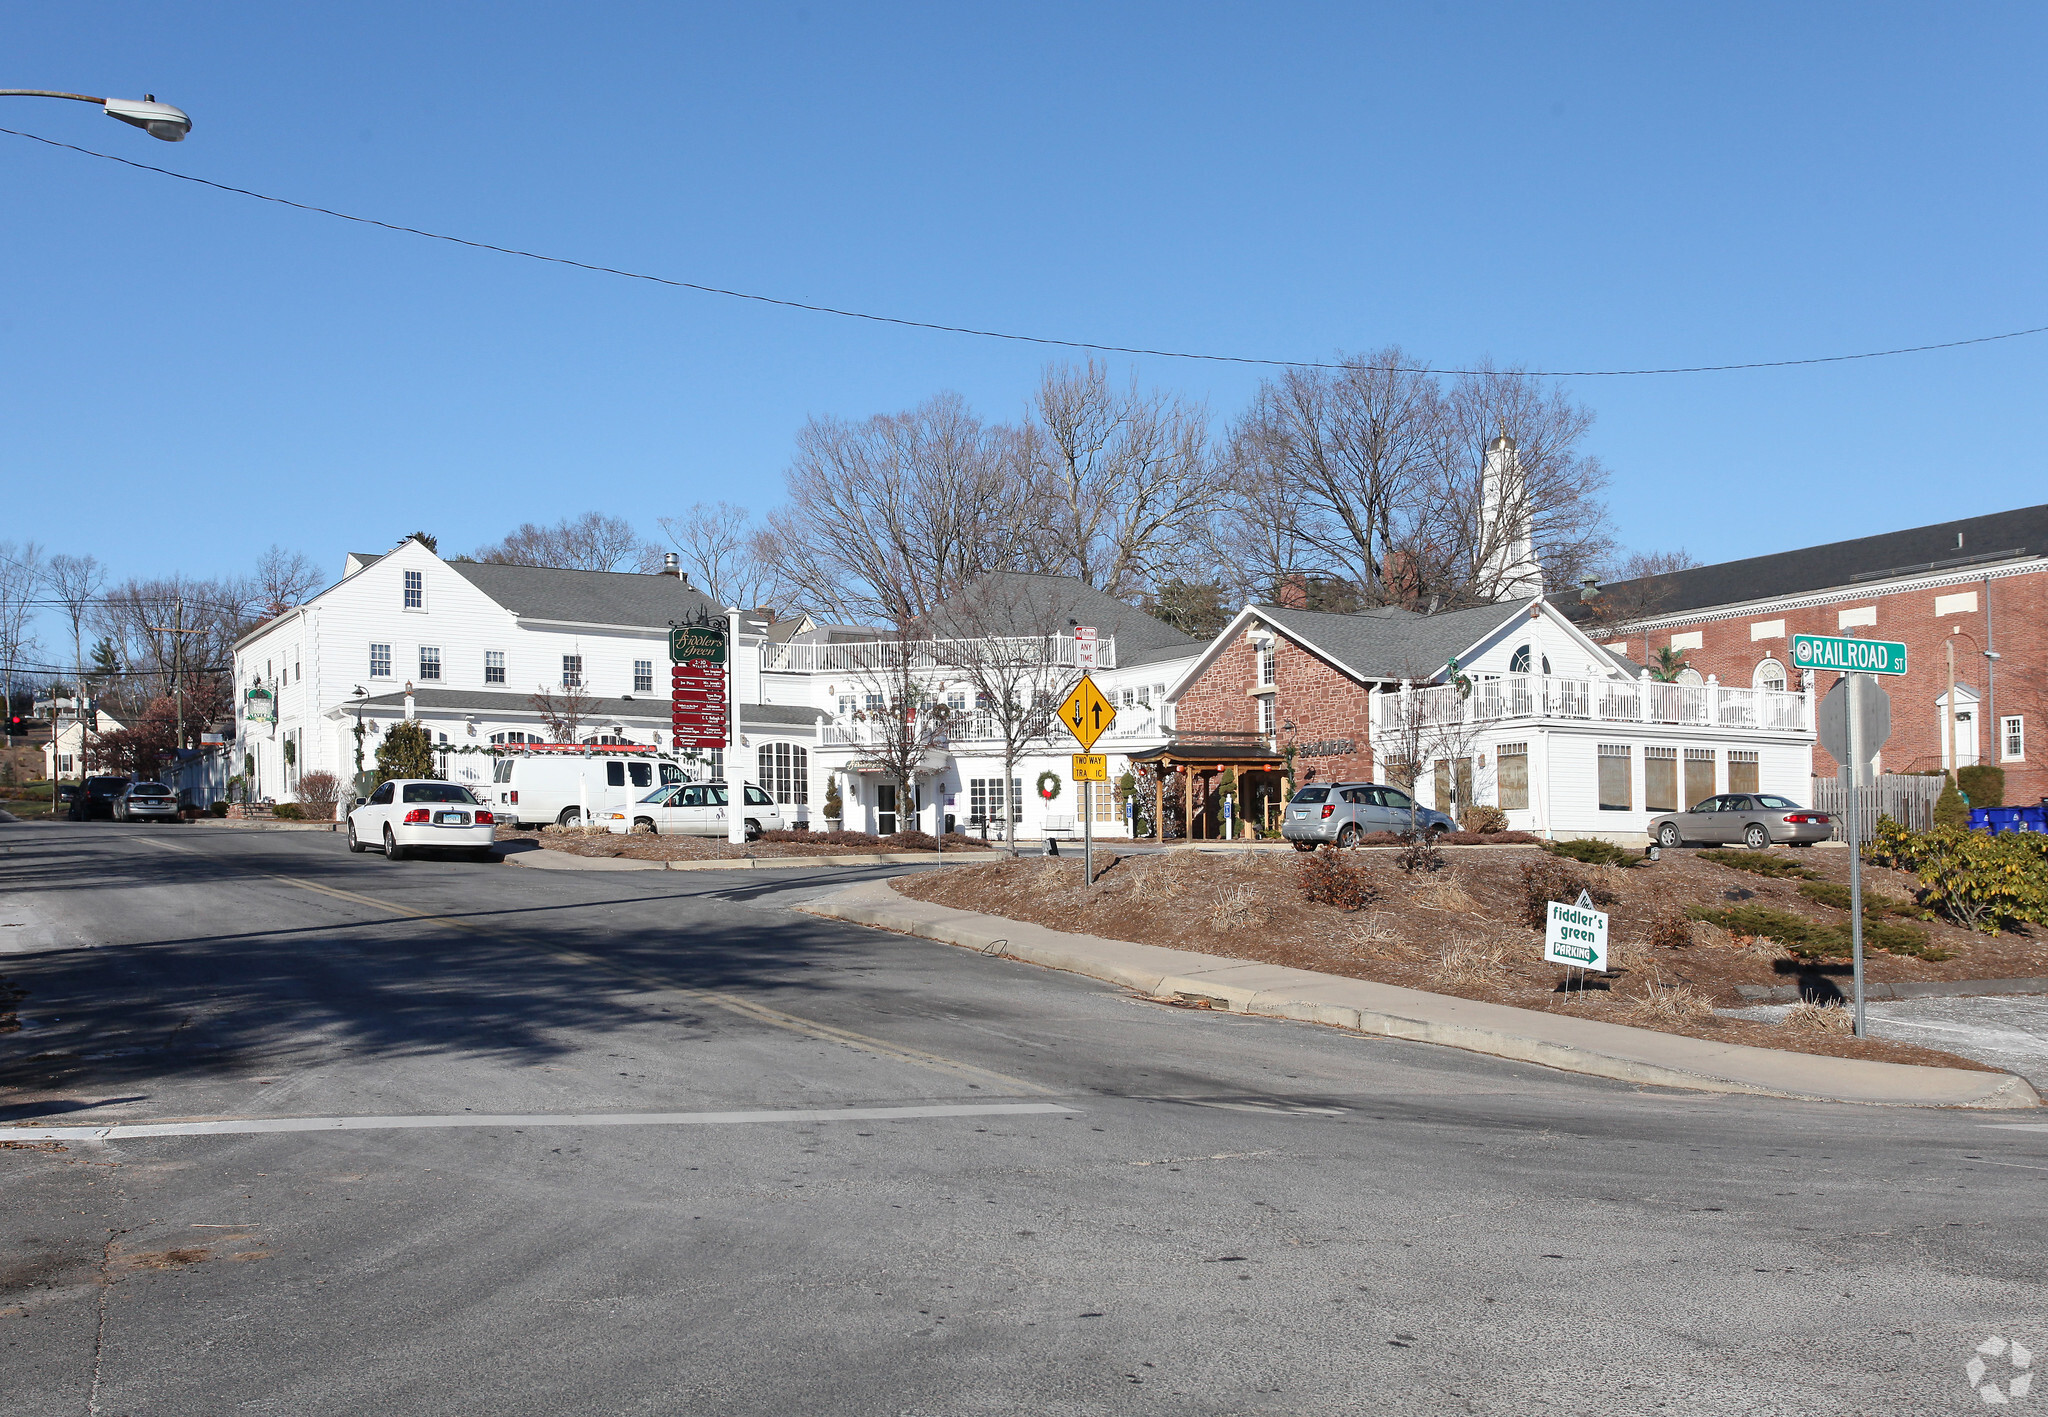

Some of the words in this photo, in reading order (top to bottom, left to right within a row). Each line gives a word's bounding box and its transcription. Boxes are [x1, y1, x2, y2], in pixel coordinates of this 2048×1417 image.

[1081, 643, 1093, 651] ANY
[1080, 653, 1093, 663] TIME
[1812, 640, 1889, 669] RAILROAD
[1894, 657, 1904, 671] ST
[1075, 756, 1087, 764] TWO
[1089, 756, 1102, 764] WAY
[1076, 769, 1103, 777] TRAIC
[1553, 906, 1603, 930] fiddler's
[1561, 926, 1595, 943] green
[1554, 942, 1590, 960] PARKING
